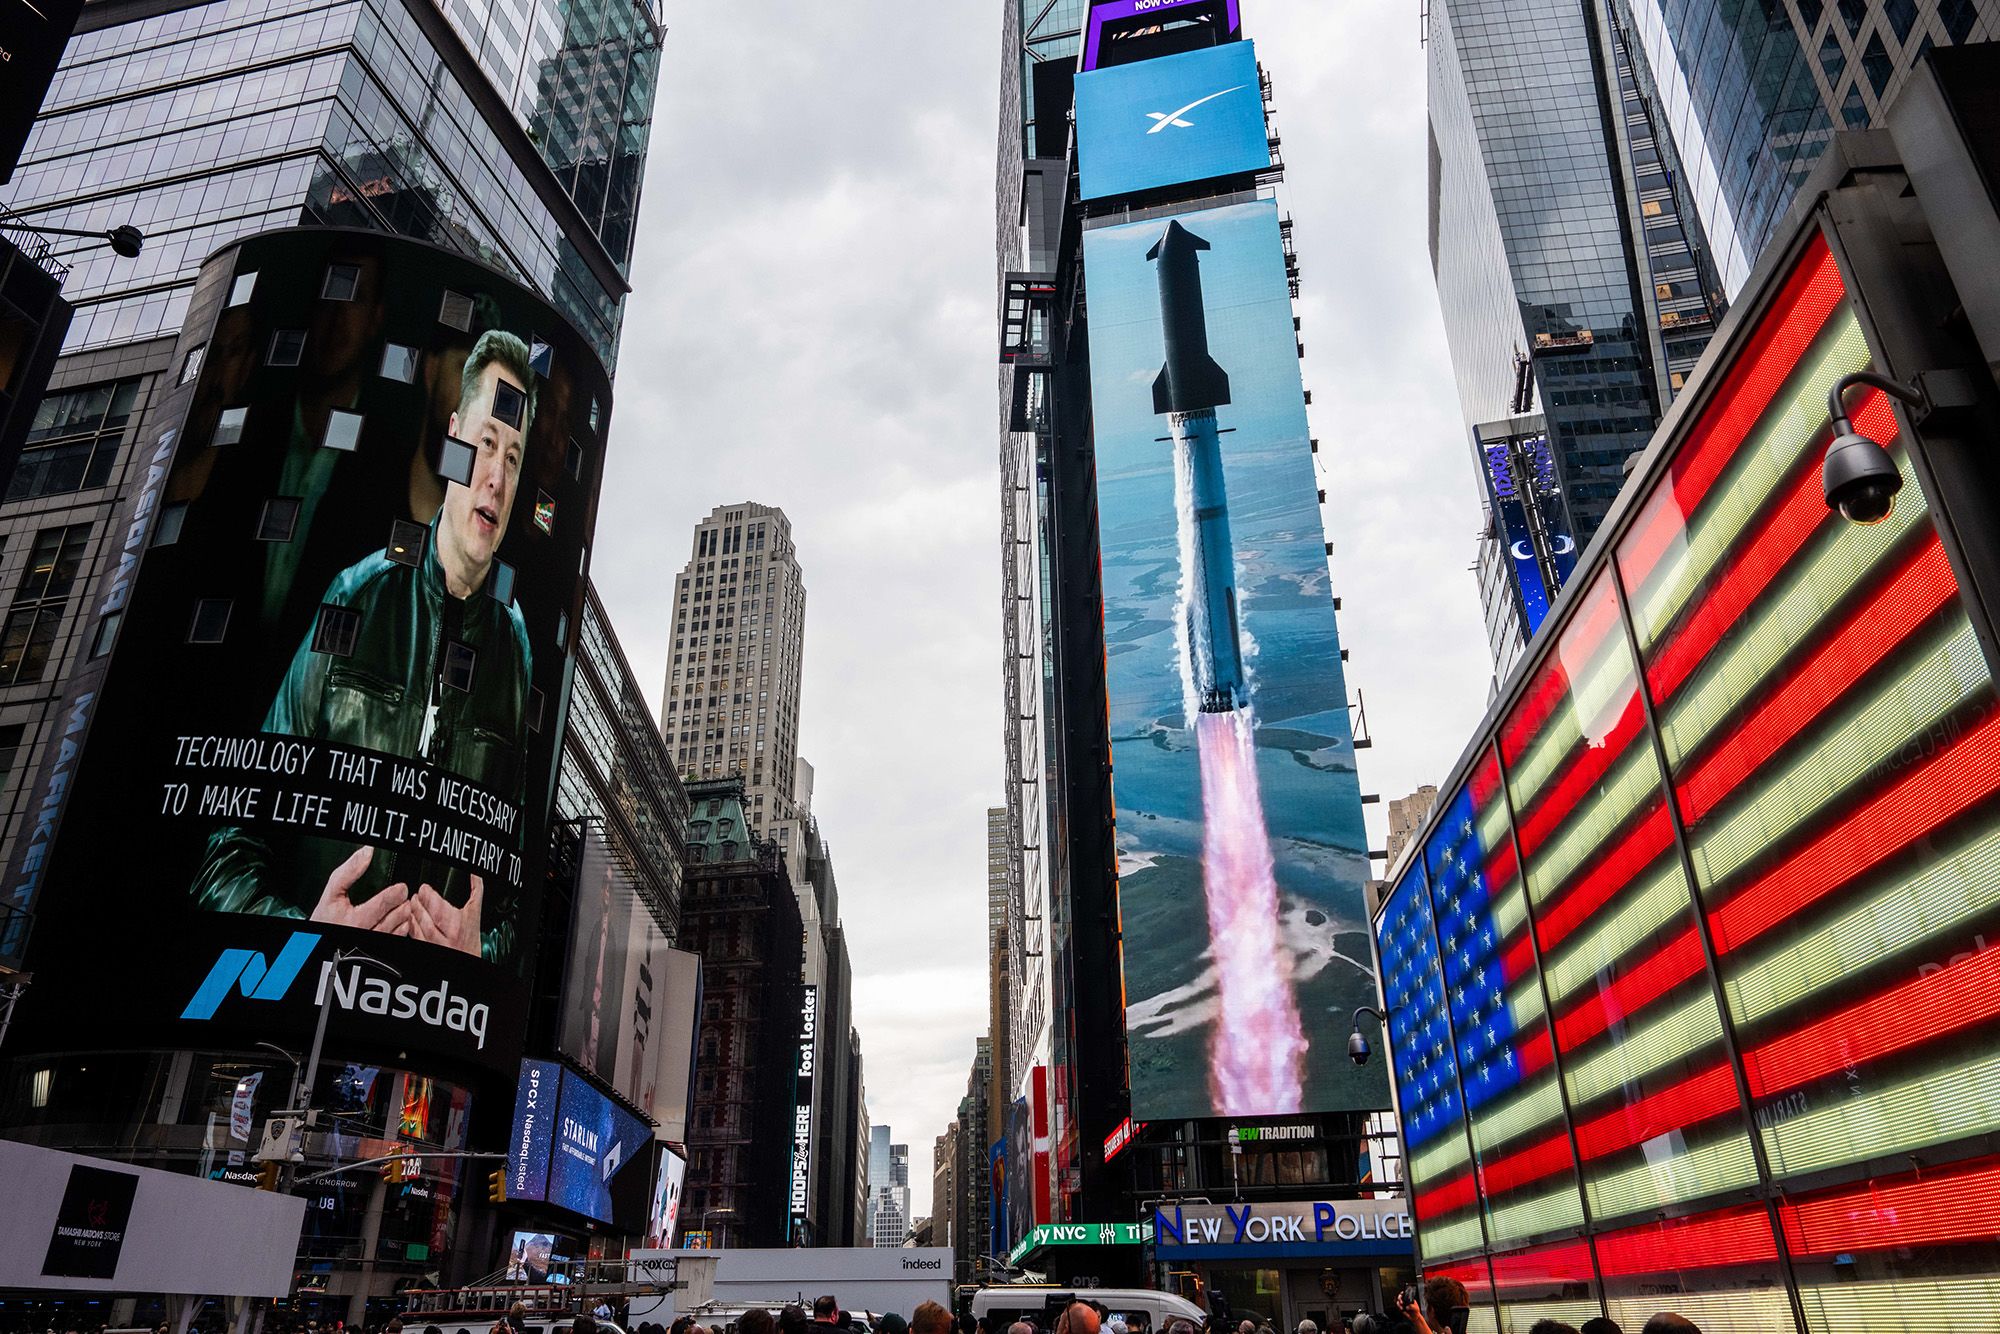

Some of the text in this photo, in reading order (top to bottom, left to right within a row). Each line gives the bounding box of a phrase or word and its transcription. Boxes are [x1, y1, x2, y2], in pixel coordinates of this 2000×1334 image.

[99, 428, 177, 616] NASDAQ
[175, 736, 518, 835] TECHNOLOGY THAT WAS NECESSARY
[161, 784, 523, 887] TO MAKE LIFE MULTI-PLANETARY TO.
[314, 961, 489, 1050] Nasdaq
[799, 1043, 813, 1076] Foot
[526, 1069, 540, 1109] SPCX
[563, 1117, 598, 1153] STARLINK
[795, 1105, 810, 1143] HERE
[791, 1161, 807, 1213] HOOPS
[104, 1231, 121, 1241] STORE
[1053, 1226, 1086, 1240] NYC
[901, 1256, 941, 1270] indeed
